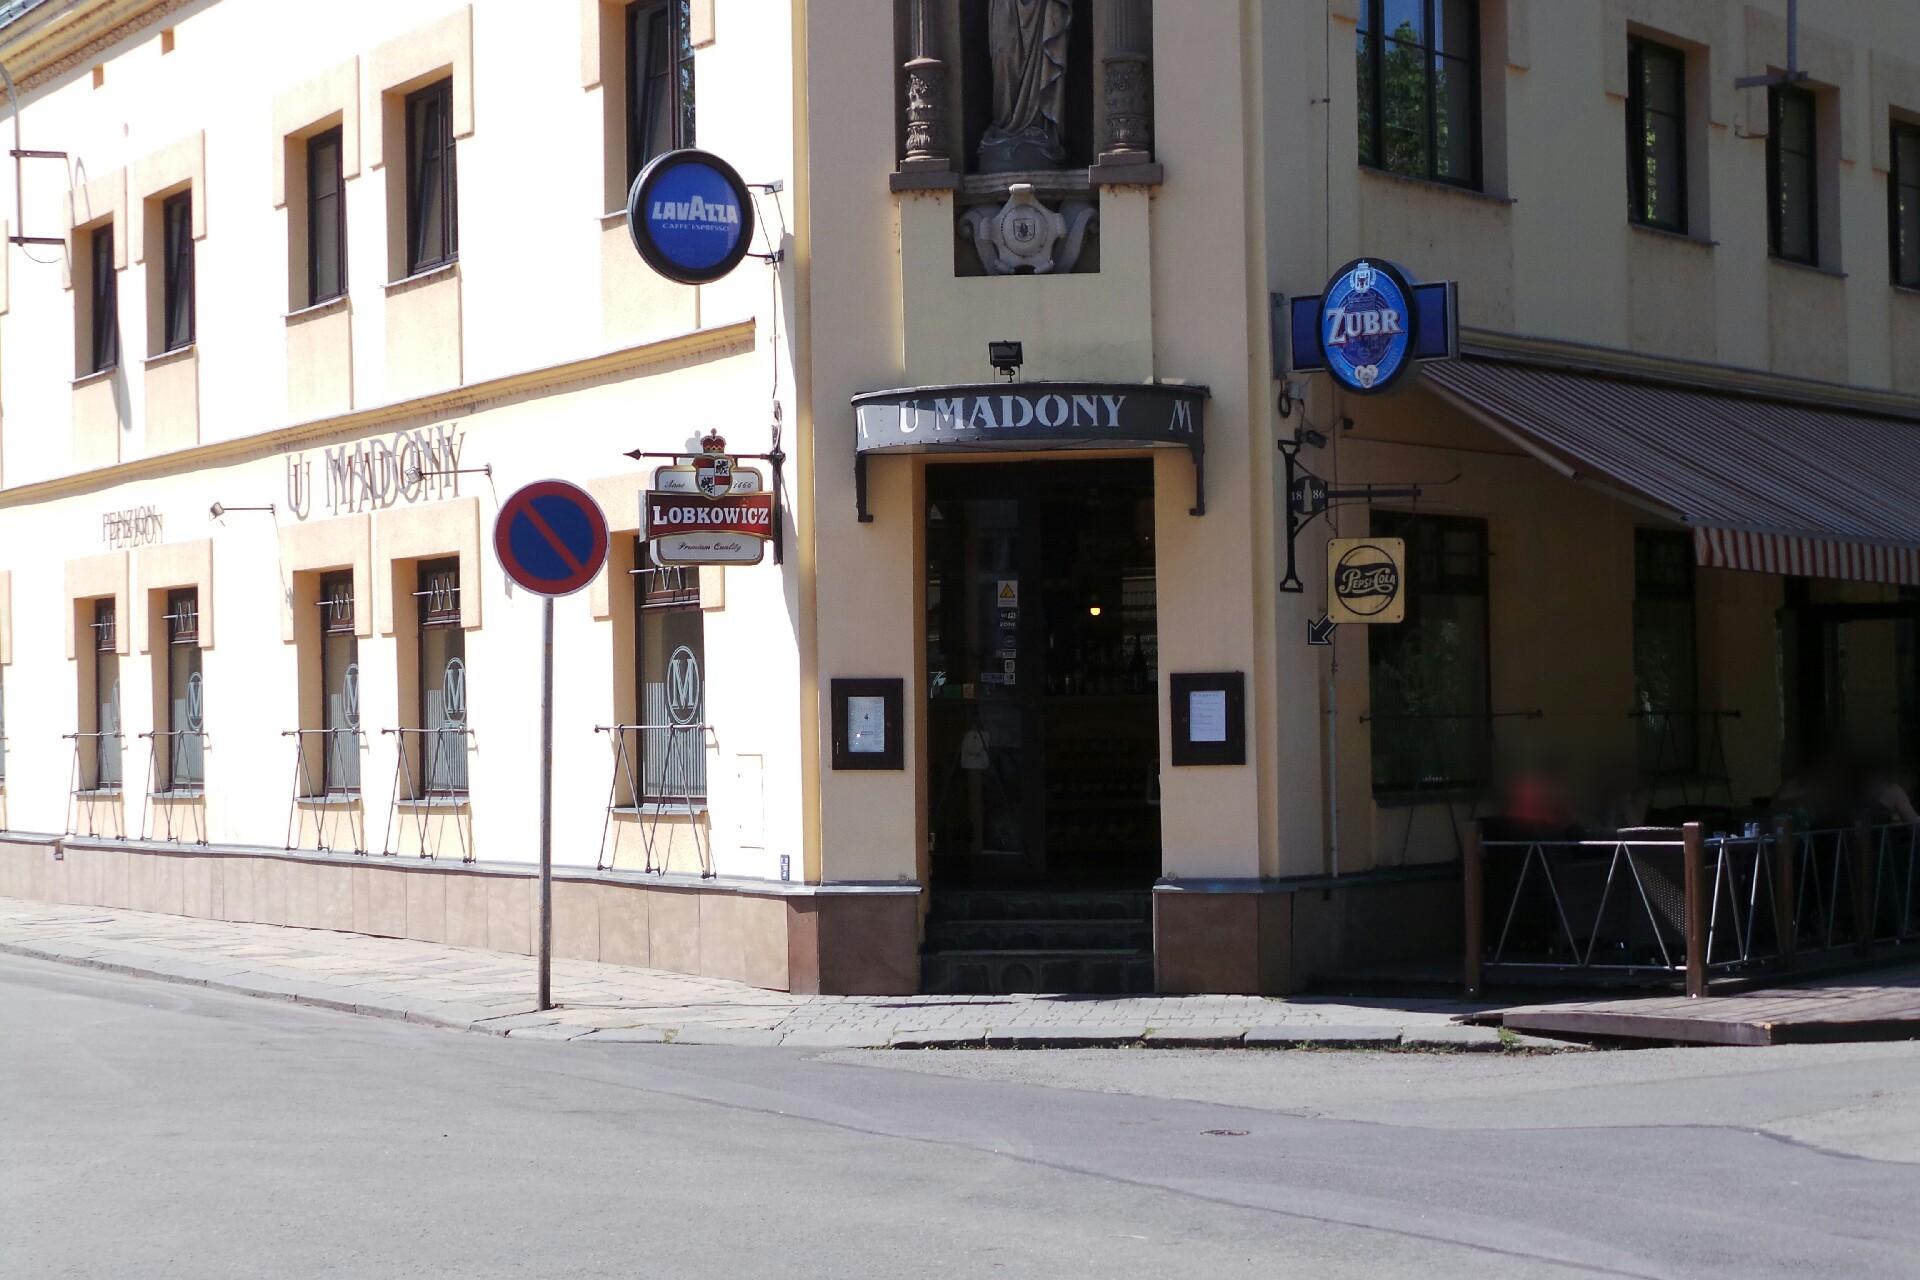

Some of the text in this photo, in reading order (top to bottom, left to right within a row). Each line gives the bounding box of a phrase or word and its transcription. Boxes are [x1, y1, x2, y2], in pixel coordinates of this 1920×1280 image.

[652, 195, 738, 223] LAVAZZA
[1326, 307, 1400, 344] ZUBR
[899, 394, 1127, 433] U MADONY
[1168, 399, 1194, 433] M
[325, 423, 461, 511] MADONY
[652, 505, 769, 525] LOBKOWICZ
